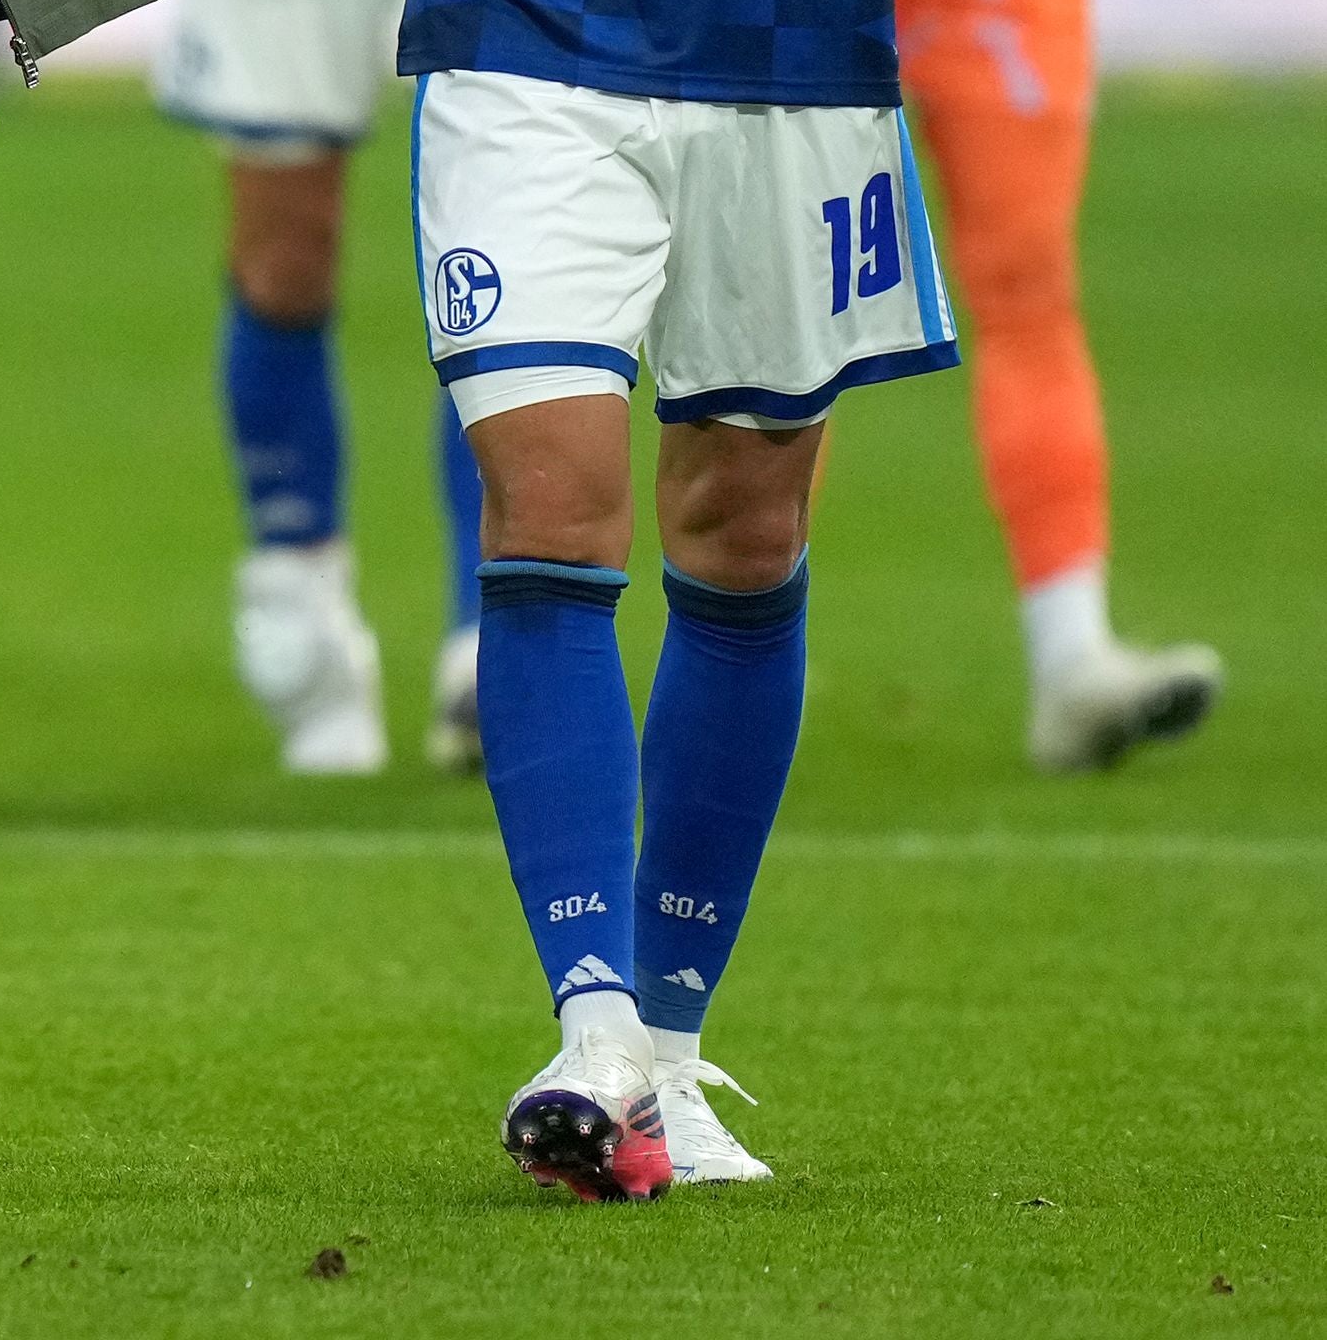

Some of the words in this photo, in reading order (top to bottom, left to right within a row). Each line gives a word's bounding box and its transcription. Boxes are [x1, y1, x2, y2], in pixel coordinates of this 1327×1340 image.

[822, 172, 902, 316] 19
[449, 255, 471, 301] S
[450, 299, 472, 328] 04
